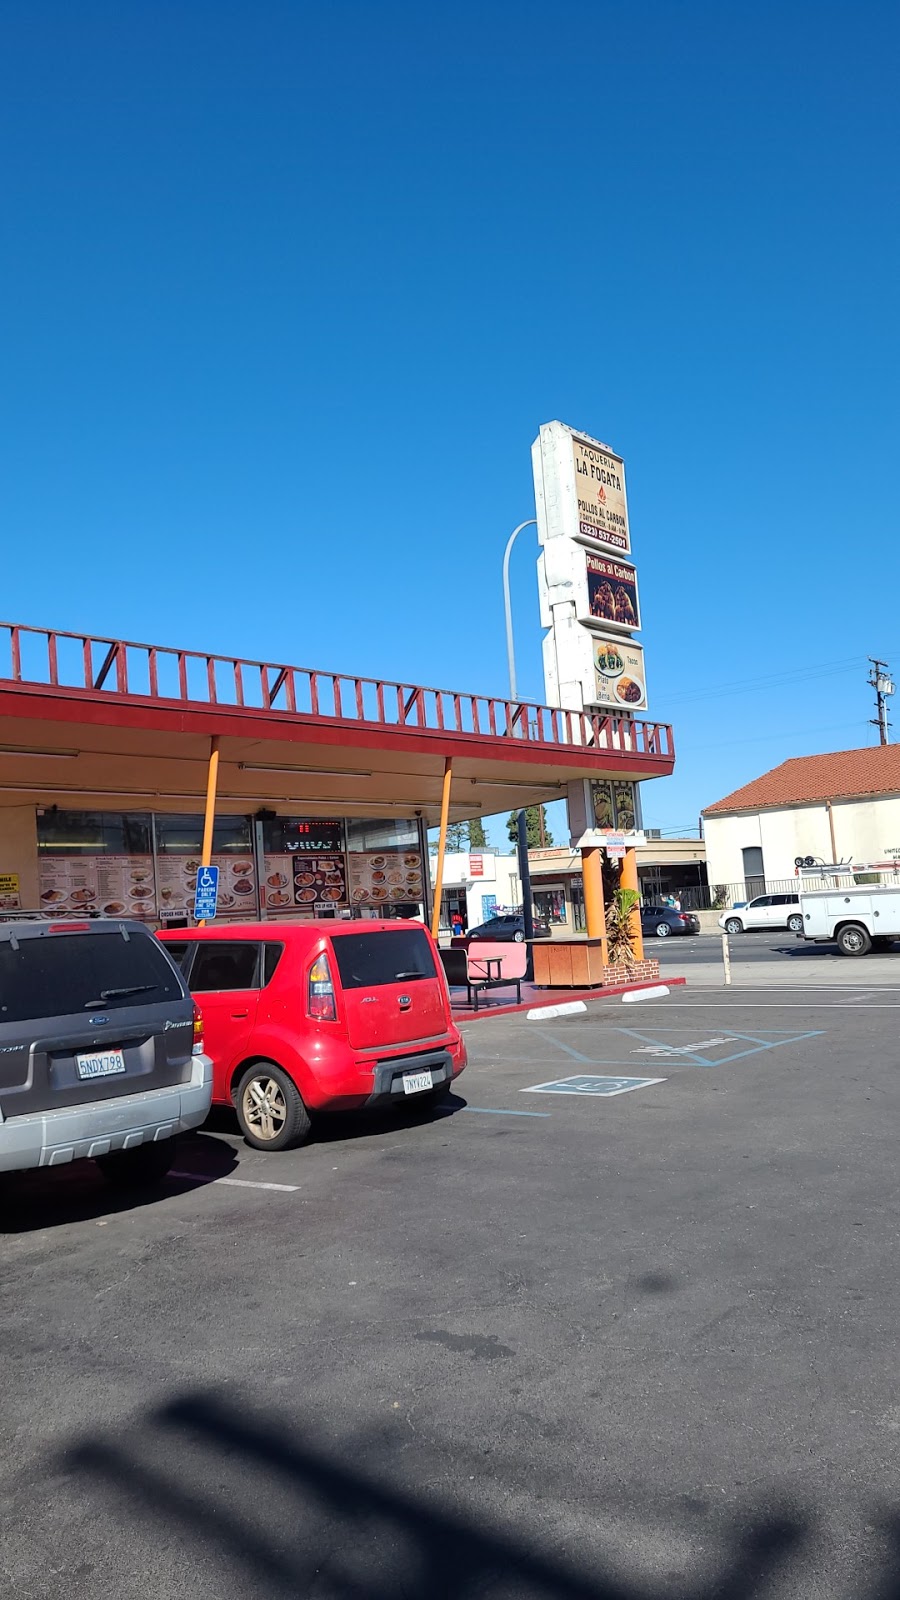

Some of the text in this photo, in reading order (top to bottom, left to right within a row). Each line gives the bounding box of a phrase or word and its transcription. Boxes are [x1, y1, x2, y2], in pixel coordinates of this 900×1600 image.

[579, 446, 616, 471] TAQUERIA
[576, 458, 622, 491] LA FOGATA
[578, 499, 598, 516] POLLOS
[599, 507, 605, 519] AL
[606, 510, 626, 527] CARBON
[581, 522, 597, 537] (323)
[598, 530, 626, 548] 537-2501
[587, 555, 635, 582] Pollos al Carbon
[79, 1055, 122, 1074] 5NDX798
